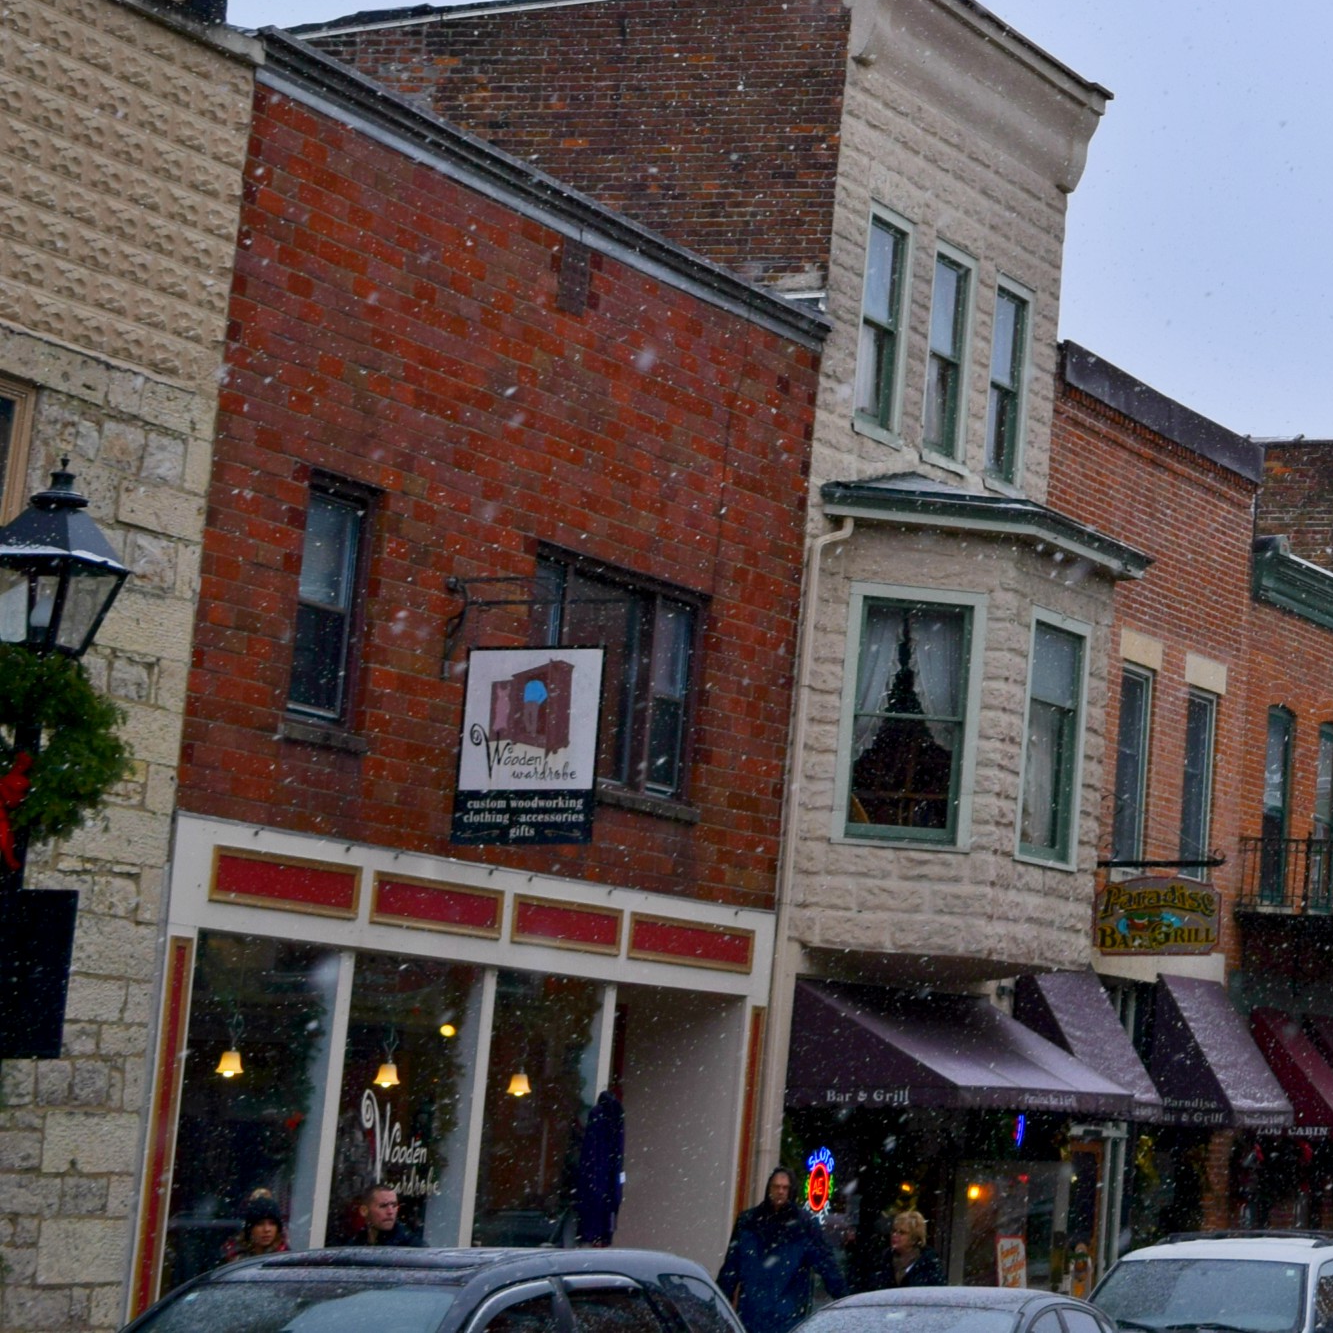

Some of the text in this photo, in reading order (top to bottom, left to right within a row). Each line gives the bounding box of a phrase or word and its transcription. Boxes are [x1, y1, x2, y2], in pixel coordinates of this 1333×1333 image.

[470, 723, 542, 779] Wooden
[511, 761, 577, 781] wardrobe
[466, 796, 584, 810] custom woodworking
[463, 810, 585, 825] clothing accessories
[508, 824, 536, 839] gifts
[1099, 884, 1217, 919] Paradise
[1150, 921, 1217, 949] GRILL
[826, 1089, 910, 1103] Bar & Grill
[361, 1088, 428, 1185] Wooden
[1288, 1126, 1329, 1136] CABIN
